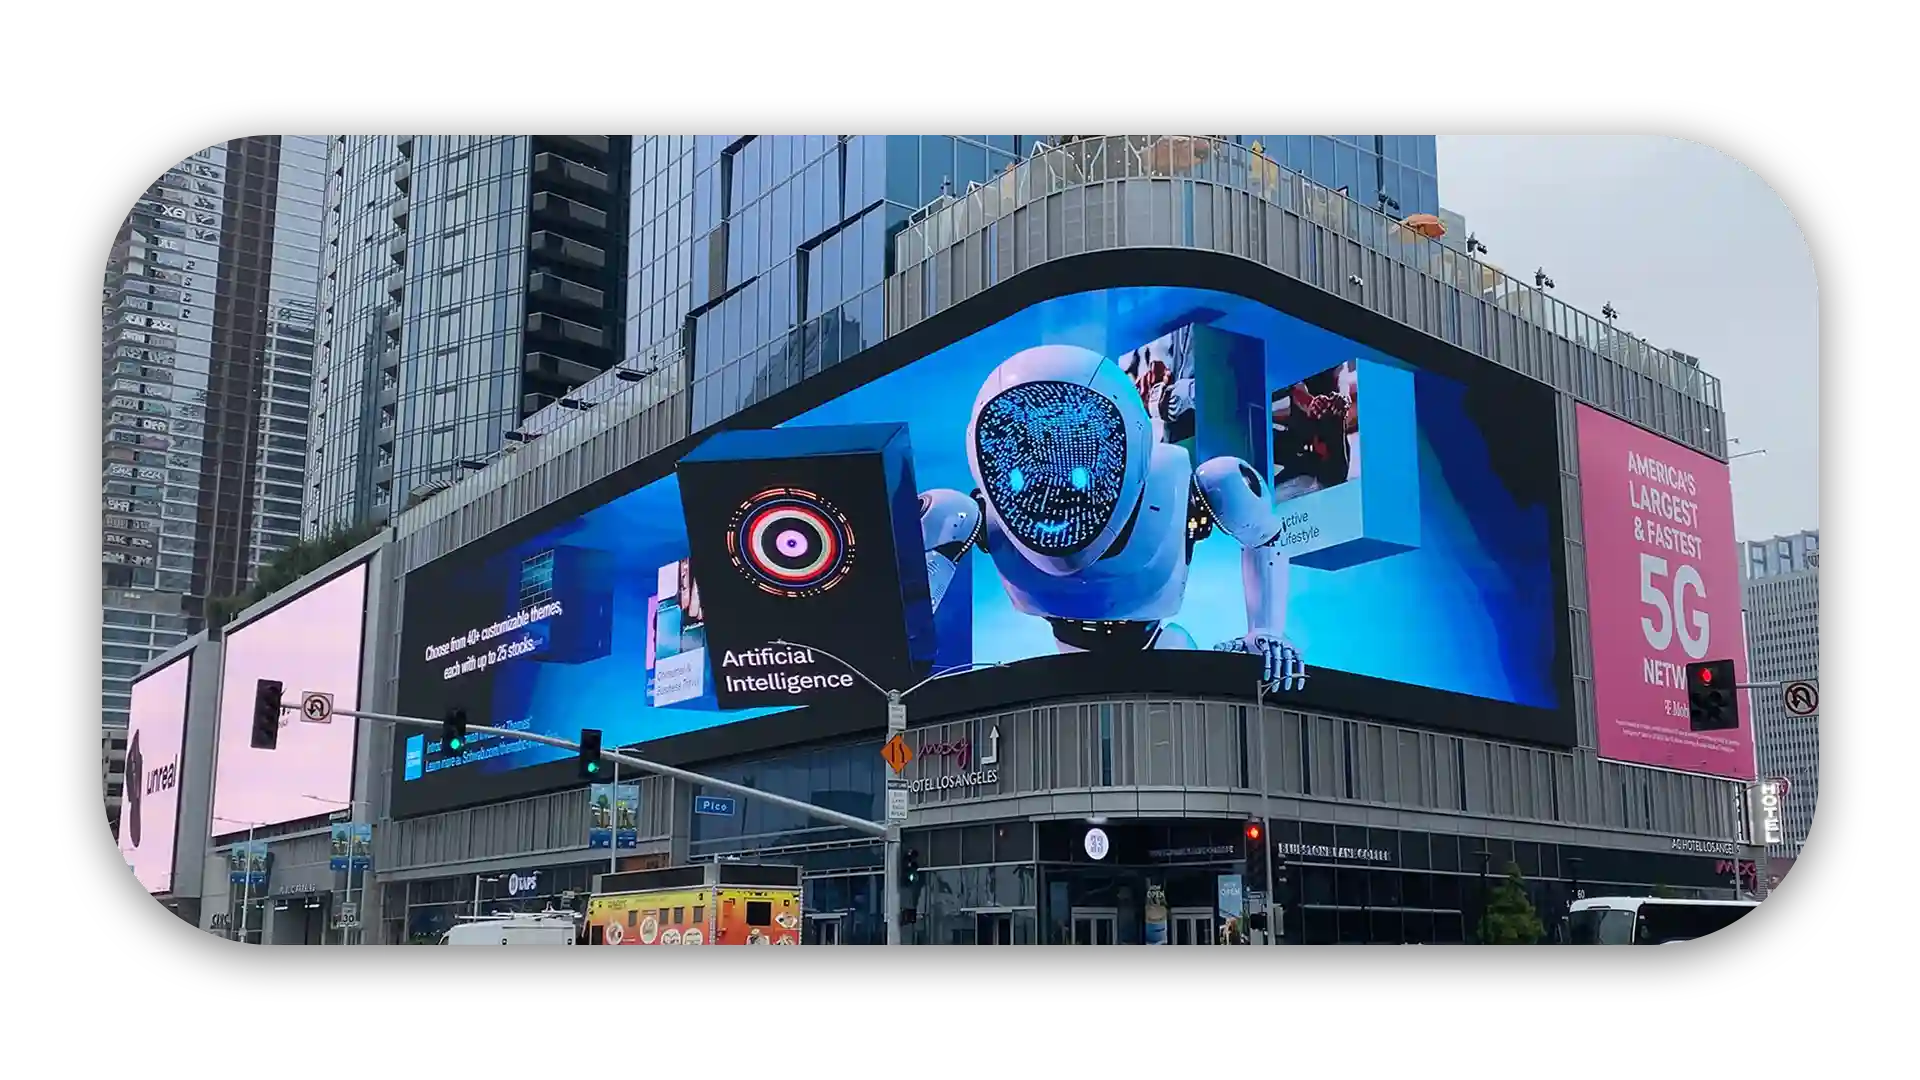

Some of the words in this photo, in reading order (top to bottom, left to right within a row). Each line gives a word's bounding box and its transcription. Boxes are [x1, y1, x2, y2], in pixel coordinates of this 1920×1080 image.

[1628, 450, 1697, 496] AMERICA'S
[1282, 512, 1308, 532] ctive
[1629, 480, 1698, 529] LARGEST
[1634, 516, 1645, 541] &
[1647, 520, 1702, 560] FASTEST
[1640, 553, 1710, 660] 5G
[425, 641, 449, 661] Choose
[450, 636, 466, 653] from
[467, 629, 480, 646] 40+
[481, 610, 529, 641] customizable
[530, 601, 563, 622] themes,
[444, 661, 460, 680] each
[461, 656, 476, 673] with
[477, 654, 487, 672] up
[488, 651, 496, 665] to
[497, 644, 507, 661] 25
[722, 648, 815, 667] Artificial
[1643, 657, 1687, 690] NETW
[726, 674, 853, 694] Intelligence
[146, 753, 178, 796] unreal
[907, 778, 934, 793] HOTEL
[937, 775, 955, 789] LOS
[955, 770, 998, 787] ANGELES
[703, 800, 727, 811] Pico
[1762, 784, 1781, 844] HOTEL
[1683, 840, 1702, 852] HOTEL
